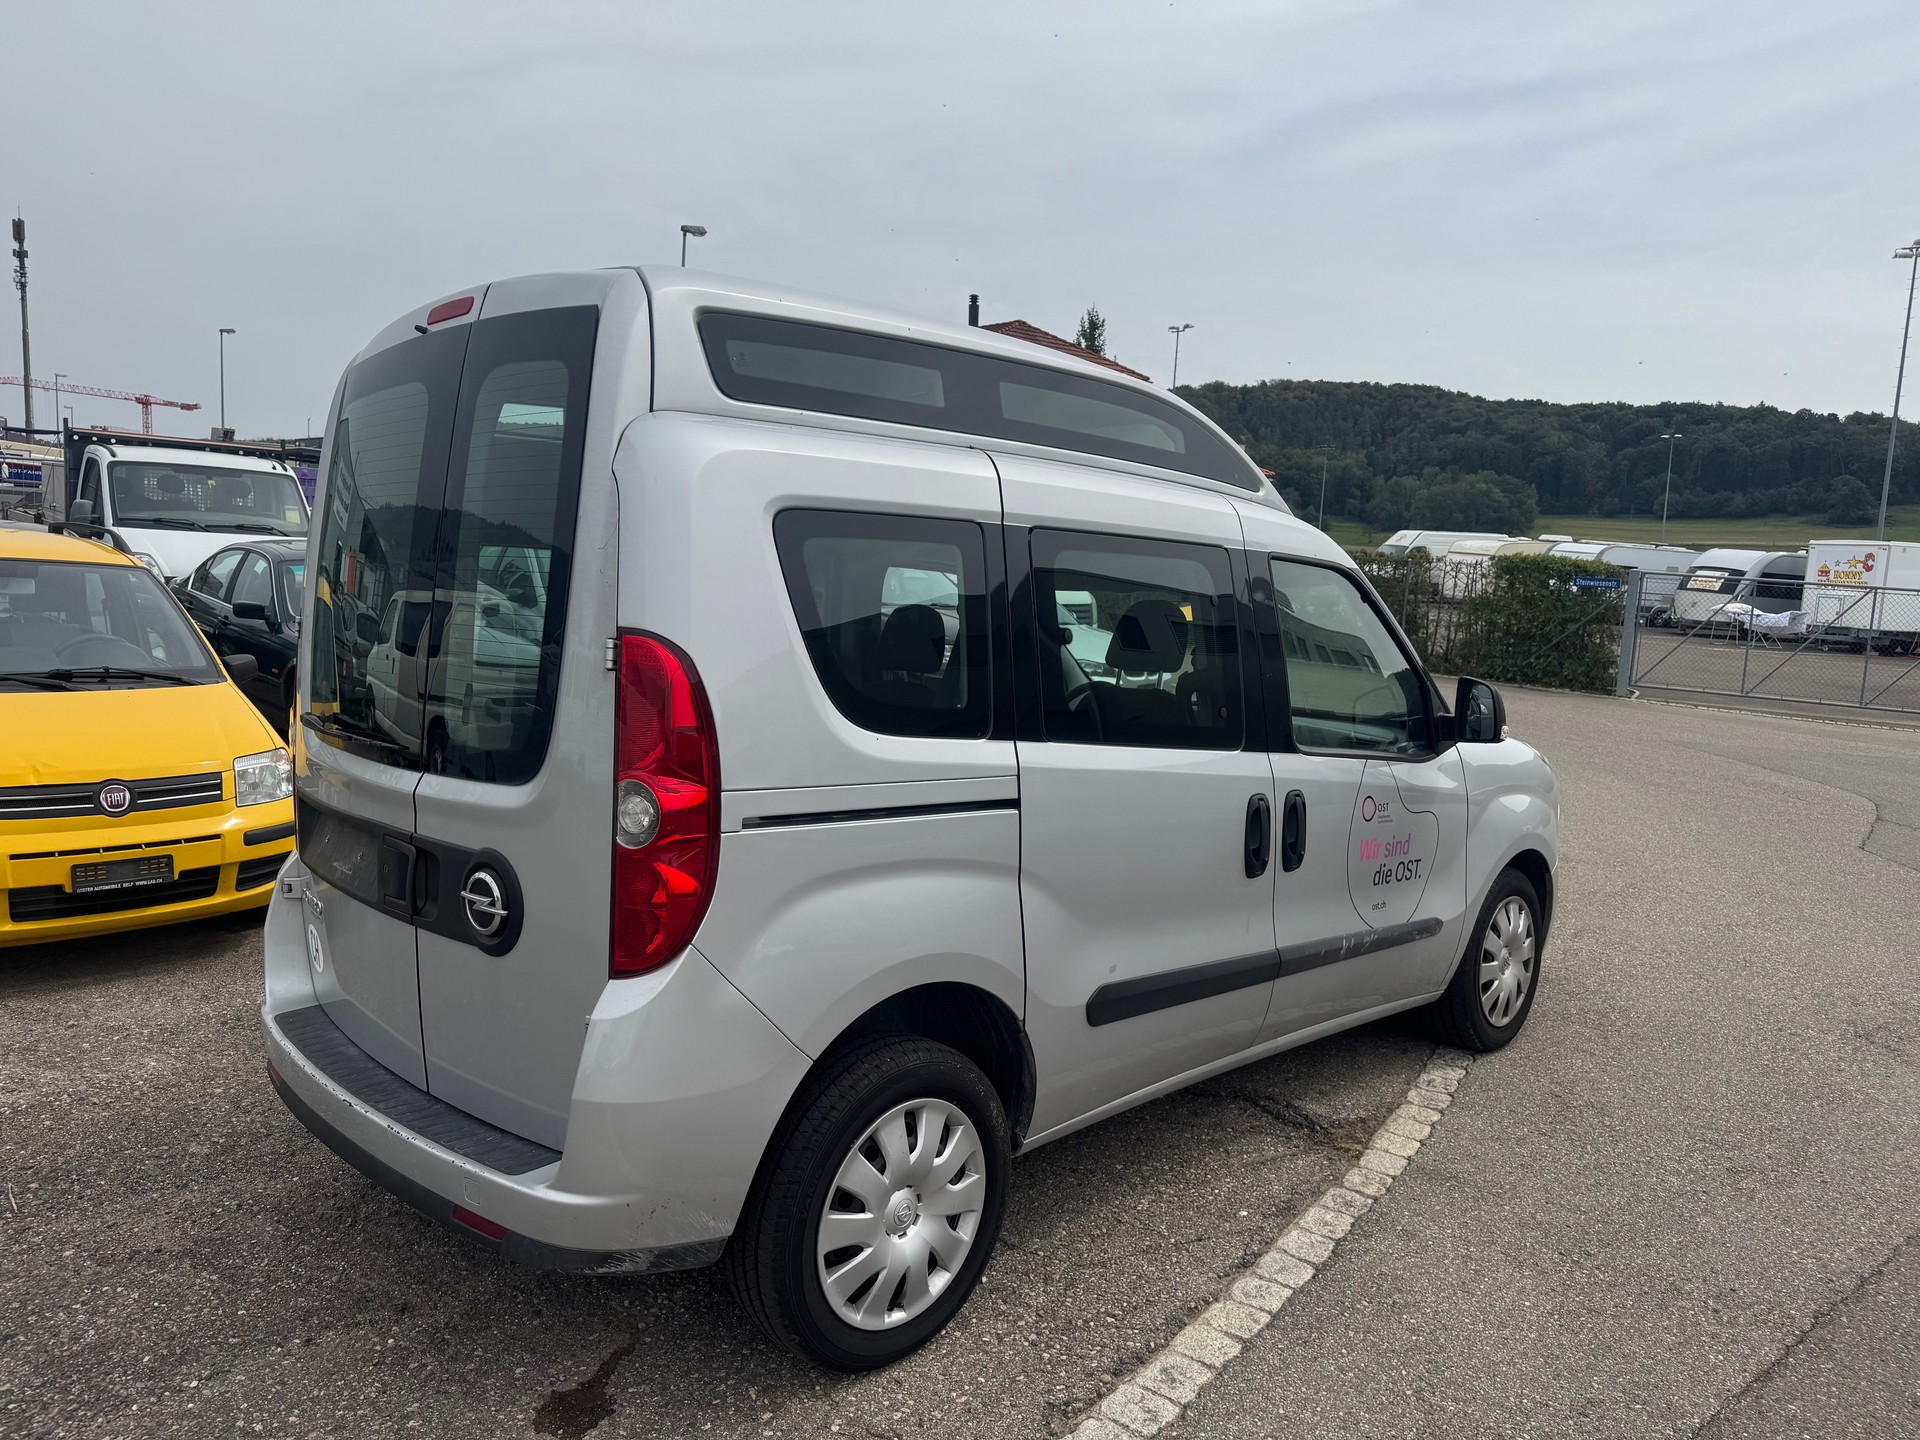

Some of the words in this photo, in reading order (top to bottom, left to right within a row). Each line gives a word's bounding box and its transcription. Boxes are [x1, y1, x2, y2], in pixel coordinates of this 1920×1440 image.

[1576, 578, 1618, 588] Steinwiesenstr.
[107, 792, 124, 806] FIAT
[1378, 803, 1389, 812] OST
[1360, 838, 1382, 861] Wir
[1384, 833, 1411, 858] sind
[1373, 863, 1392, 886] die
[1395, 859, 1421, 882] OST.
[1371, 900, 1387, 911] ost.ch
